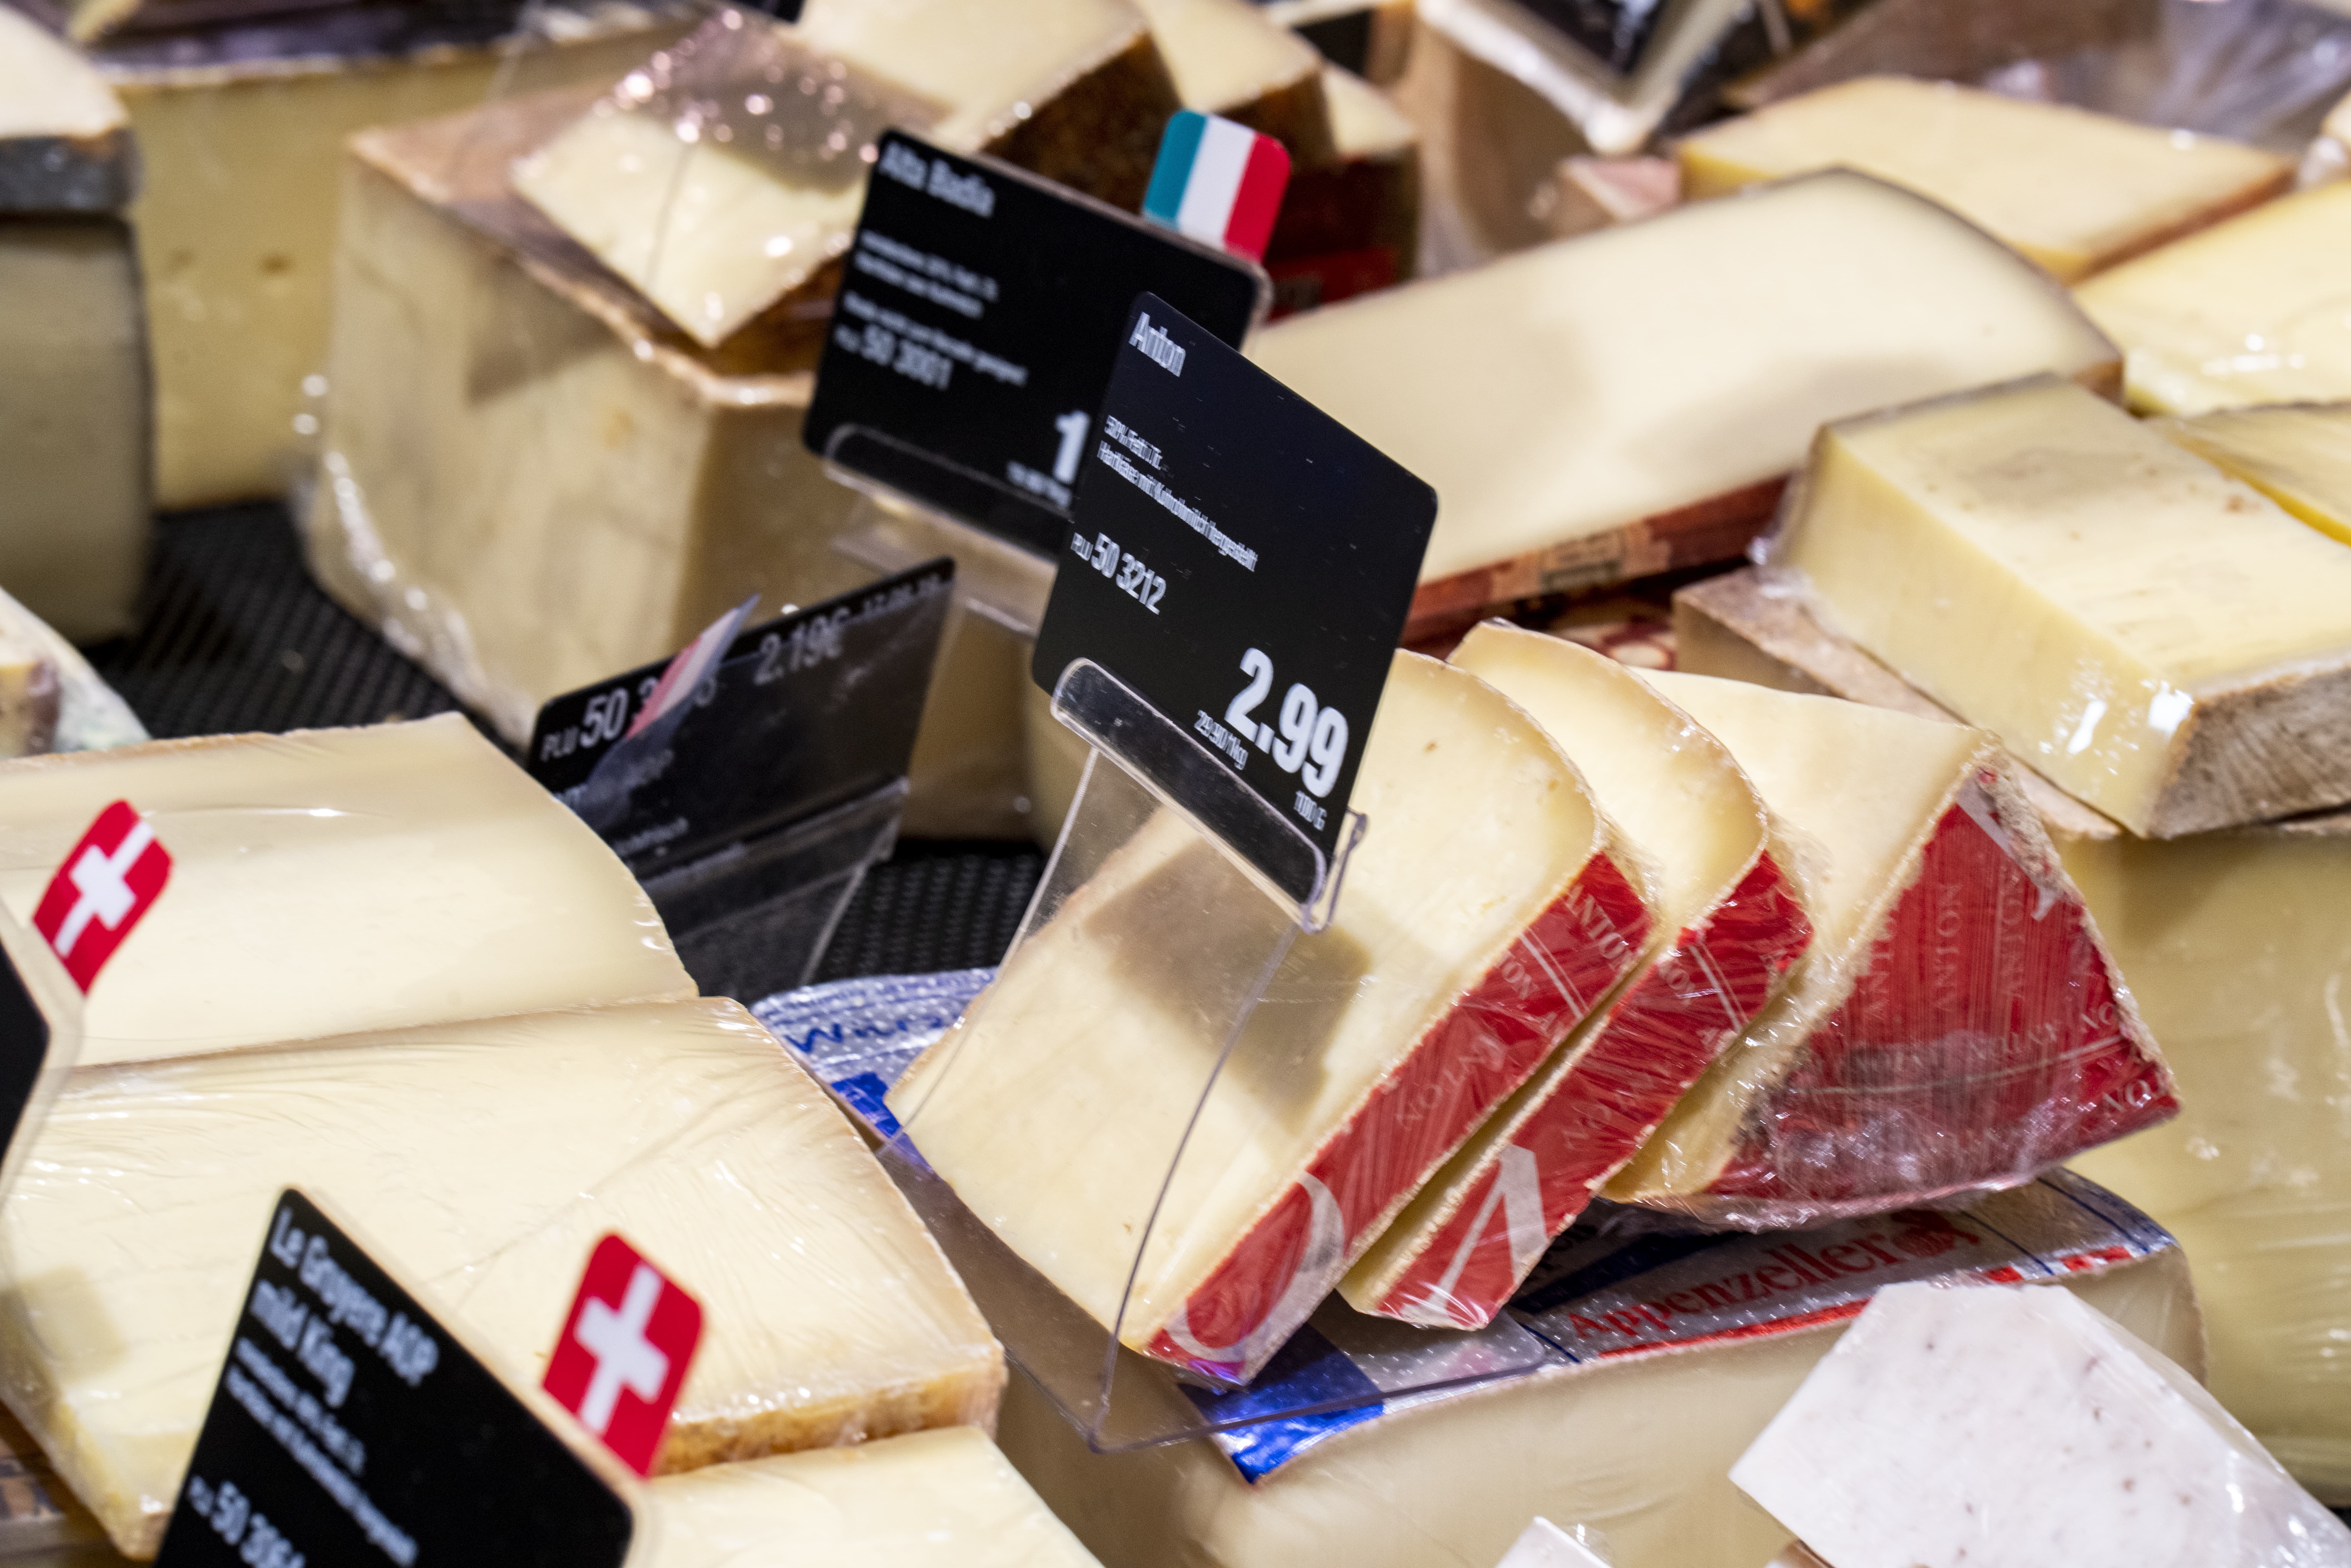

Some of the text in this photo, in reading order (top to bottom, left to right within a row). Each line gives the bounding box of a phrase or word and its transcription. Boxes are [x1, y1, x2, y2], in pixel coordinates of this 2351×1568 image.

[1129, 312, 1186, 377] Anton
[1071, 533, 1166, 615] PLU 50 3212
[580, 689, 627, 747] 50
[1224, 648, 1349, 797] 2.99
[270, 1207, 306, 1269] Le
[1567, 1231, 1902, 1339] Appenzeller
